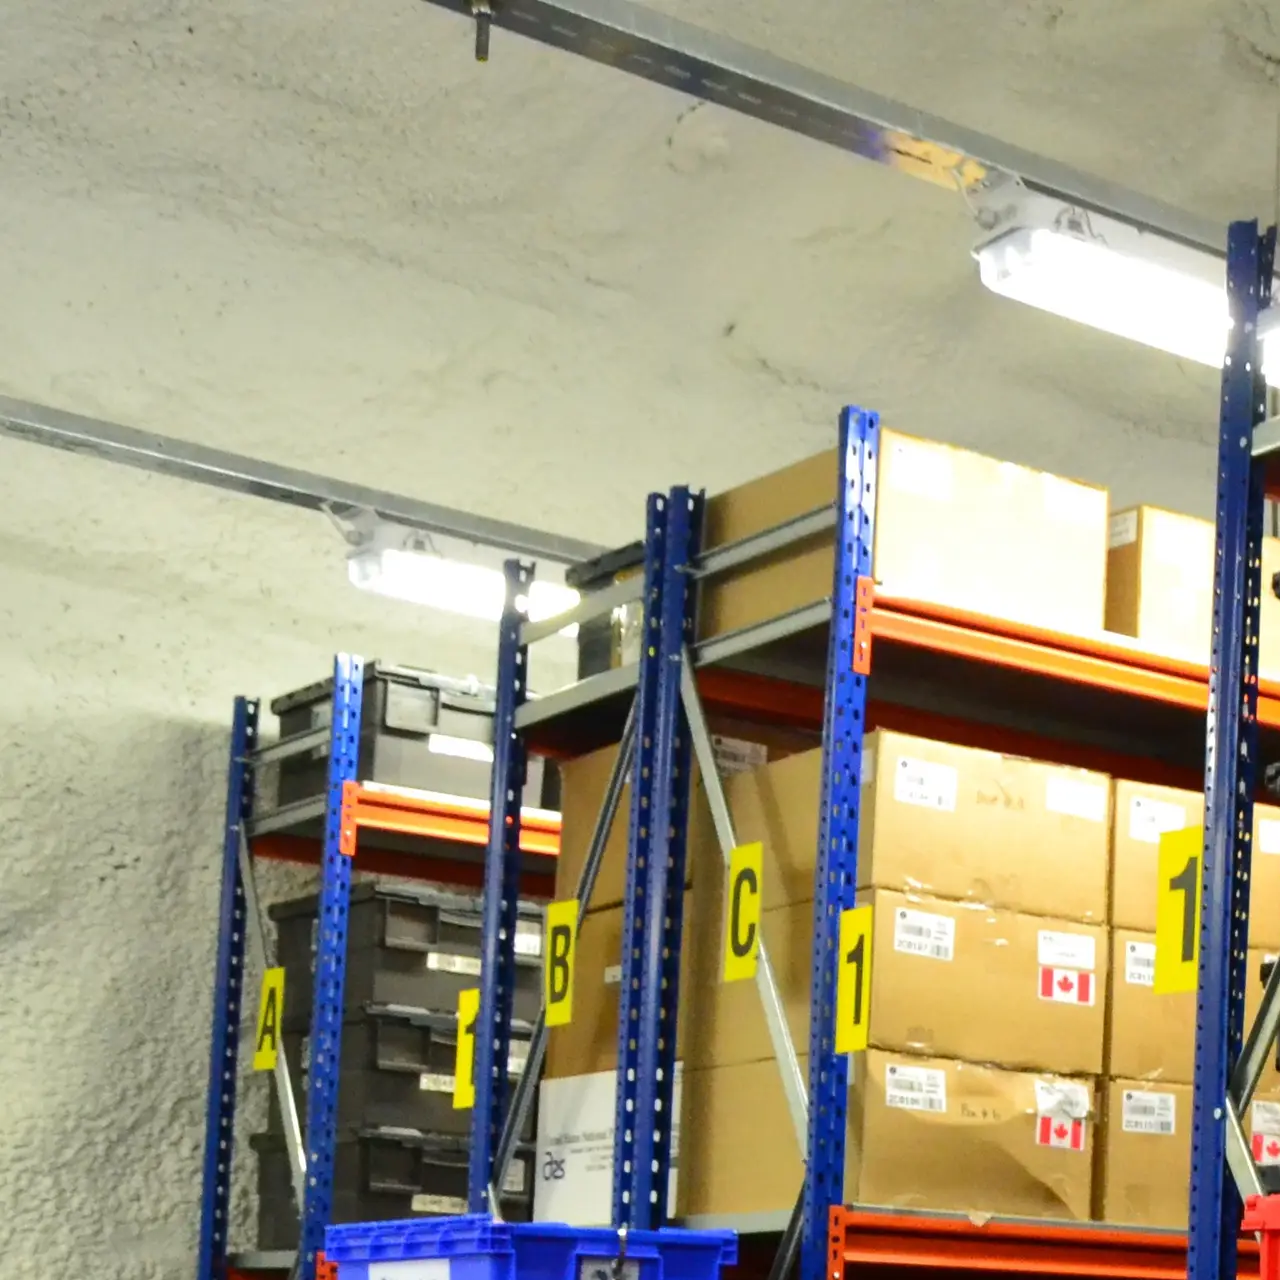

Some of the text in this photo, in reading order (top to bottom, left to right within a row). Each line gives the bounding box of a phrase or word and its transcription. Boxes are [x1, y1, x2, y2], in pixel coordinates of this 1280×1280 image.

[730, 866, 758, 957] C
[1169, 856, 1198, 963] 1
[548, 924, 571, 1004] B
[846, 934, 864, 1025] 1
[257, 997, 278, 1051] A
